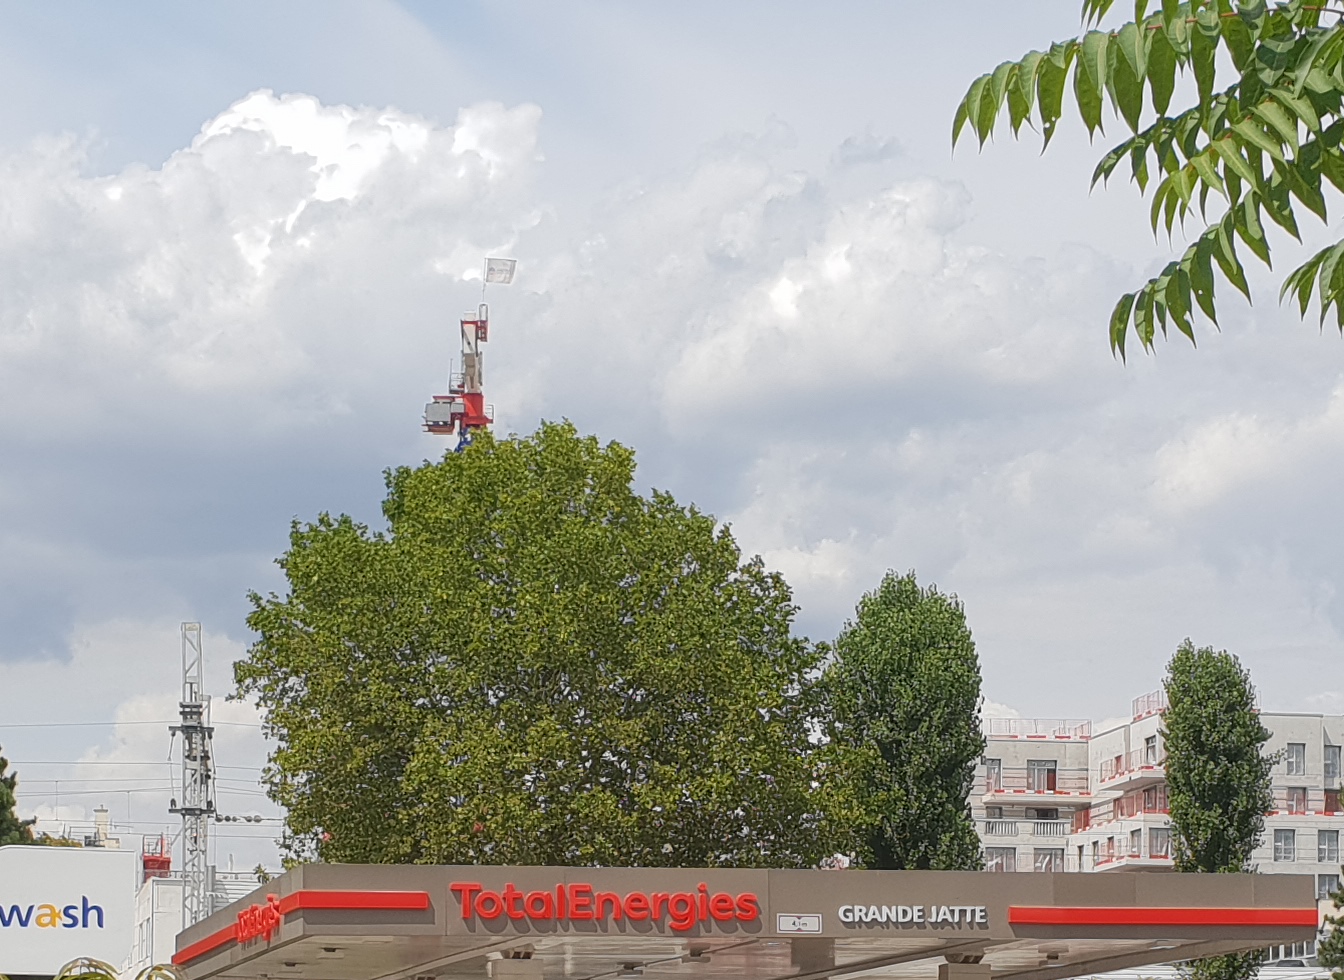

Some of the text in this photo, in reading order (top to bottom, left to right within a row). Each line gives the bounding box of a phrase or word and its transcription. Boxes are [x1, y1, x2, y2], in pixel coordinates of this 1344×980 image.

[449, 881, 759, 931] TotalEnergies
[838, 904, 987, 923] GRANDE JATTE
